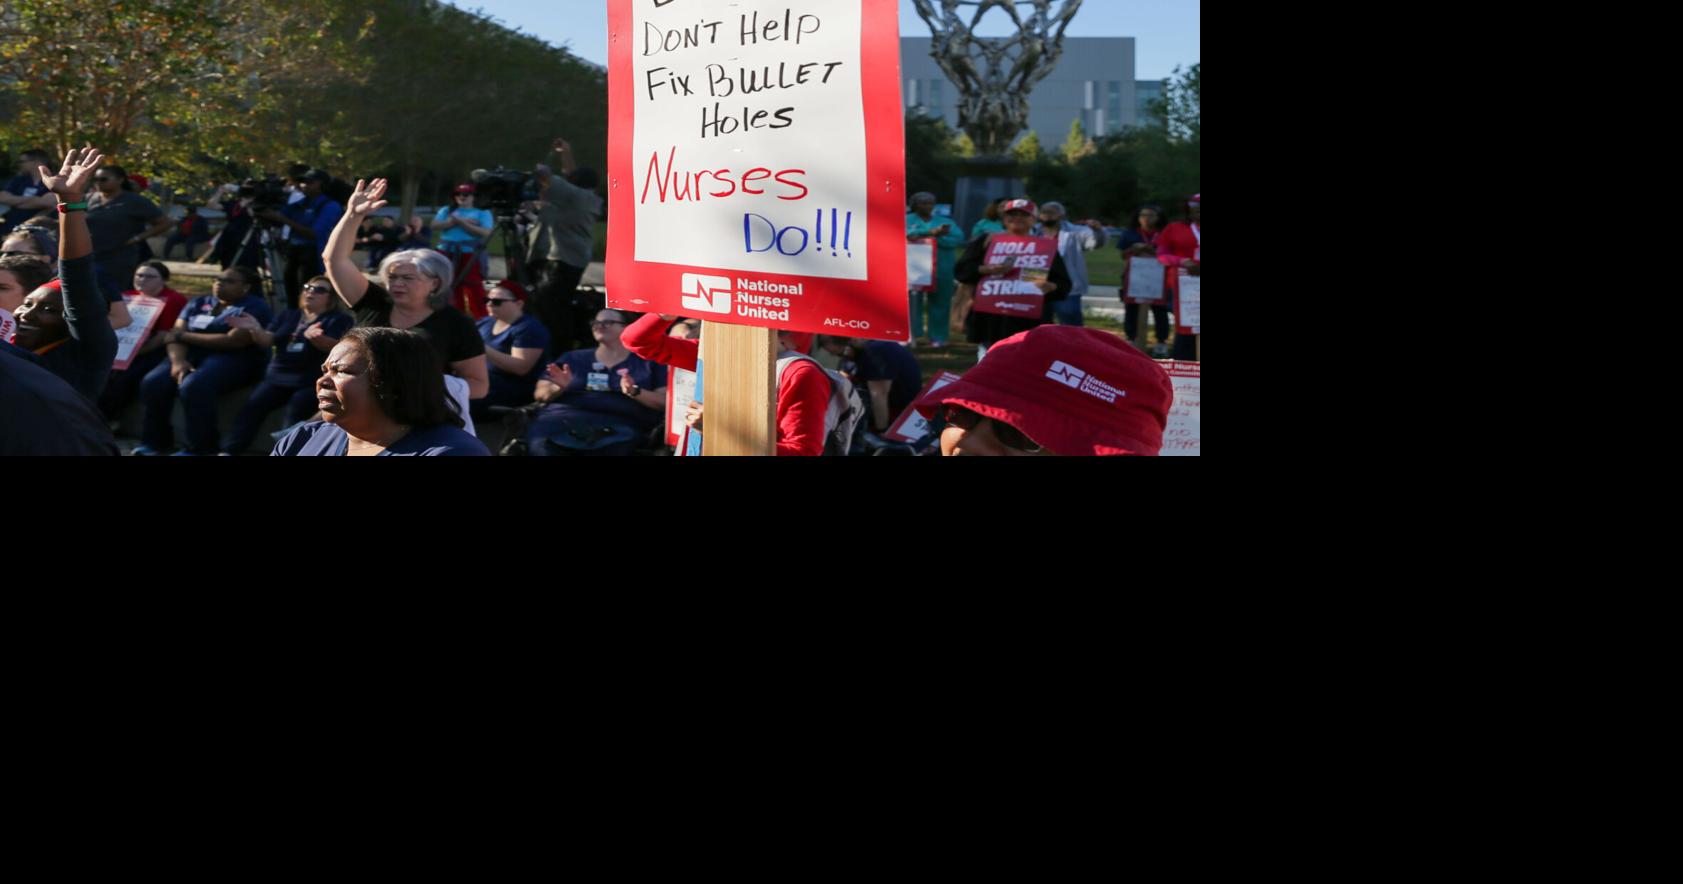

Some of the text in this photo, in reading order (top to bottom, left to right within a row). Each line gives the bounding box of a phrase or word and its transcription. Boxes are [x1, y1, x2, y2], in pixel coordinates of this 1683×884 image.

[642, 19, 723, 56] DON'T
[647, 62, 843, 101] Fix BULLET
[701, 102, 795, 138] Holes
[641, 145, 809, 205] Nurses
[737, 278, 803, 296] National
[737, 291, 790, 308] Nurses
[737, 305, 789, 322] United
[824, 317, 870, 330] AFL-CIO
[1080, 384, 1115, 404] United
[1083, 381, 1117, 399] Nurses
[1085, 374, 1126, 397] National
